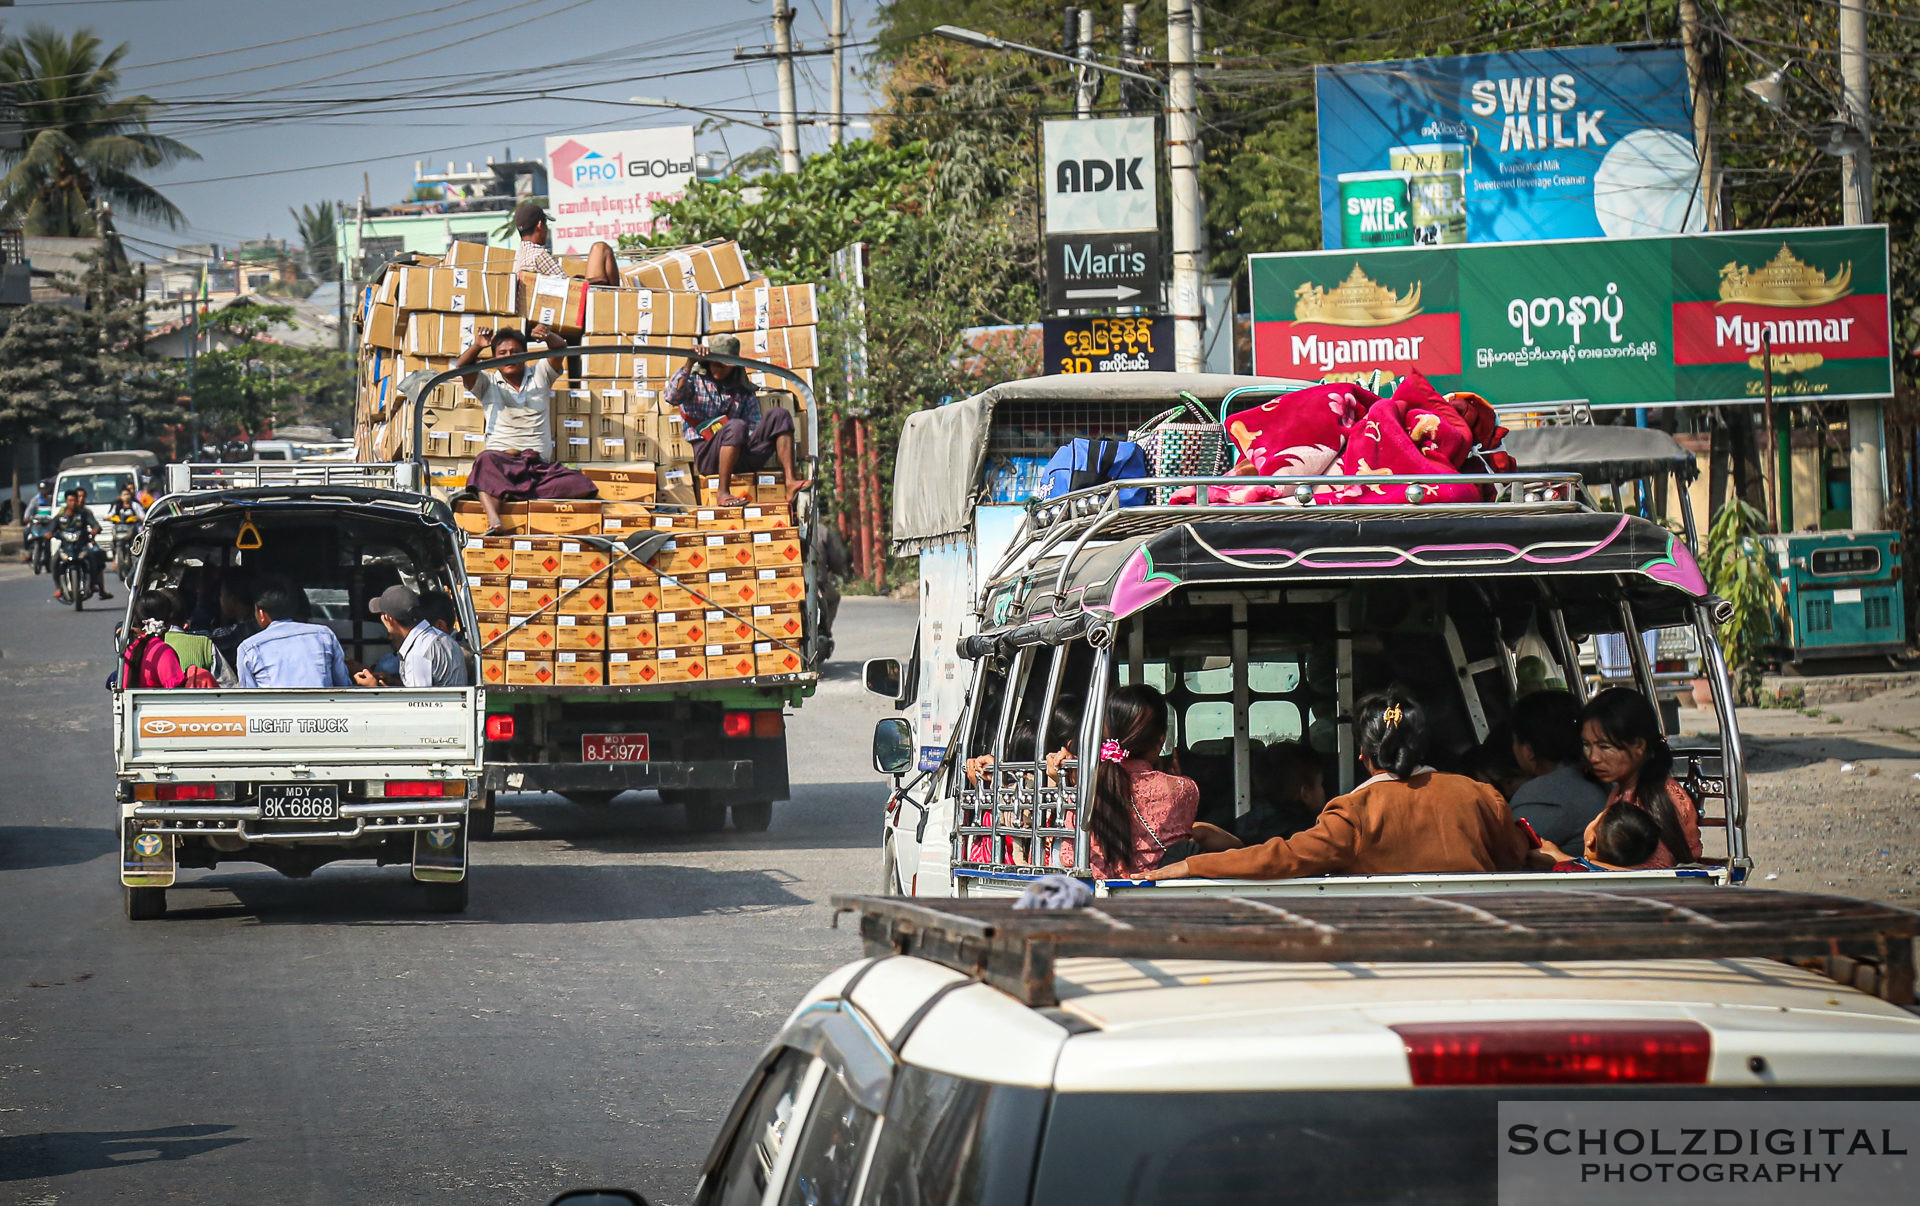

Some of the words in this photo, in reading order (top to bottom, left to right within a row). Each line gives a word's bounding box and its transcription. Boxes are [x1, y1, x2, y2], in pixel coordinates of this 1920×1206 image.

[1472, 73, 1577, 117] SWIS
[1500, 109, 1608, 153] MILK
[1401, 153, 1454, 171] FREE
[1543, 159, 1561, 171] Milk
[1057, 157, 1144, 193] ADK
[1552, 174, 1587, 186] Creamer
[1347, 196, 1396, 216] SWIS
[1360, 210, 1409, 233] MILK
[1064, 243, 1146, 275] Mari's
[1715, 315, 1855, 353] Myanmar
[1290, 334, 1424, 371] Myanmar
[1060, 357, 1093, 374] 3D
[178, 722, 244, 733] TOYOTA
[249, 719, 294, 733] LIGHT
[297, 718, 349, 733] TRUCK
[604, 735, 626, 744] MDY
[587, 744, 645, 761] 8J-3977
[285, 787, 312, 797] MDY
[264, 797, 333, 817] 8K-6868
